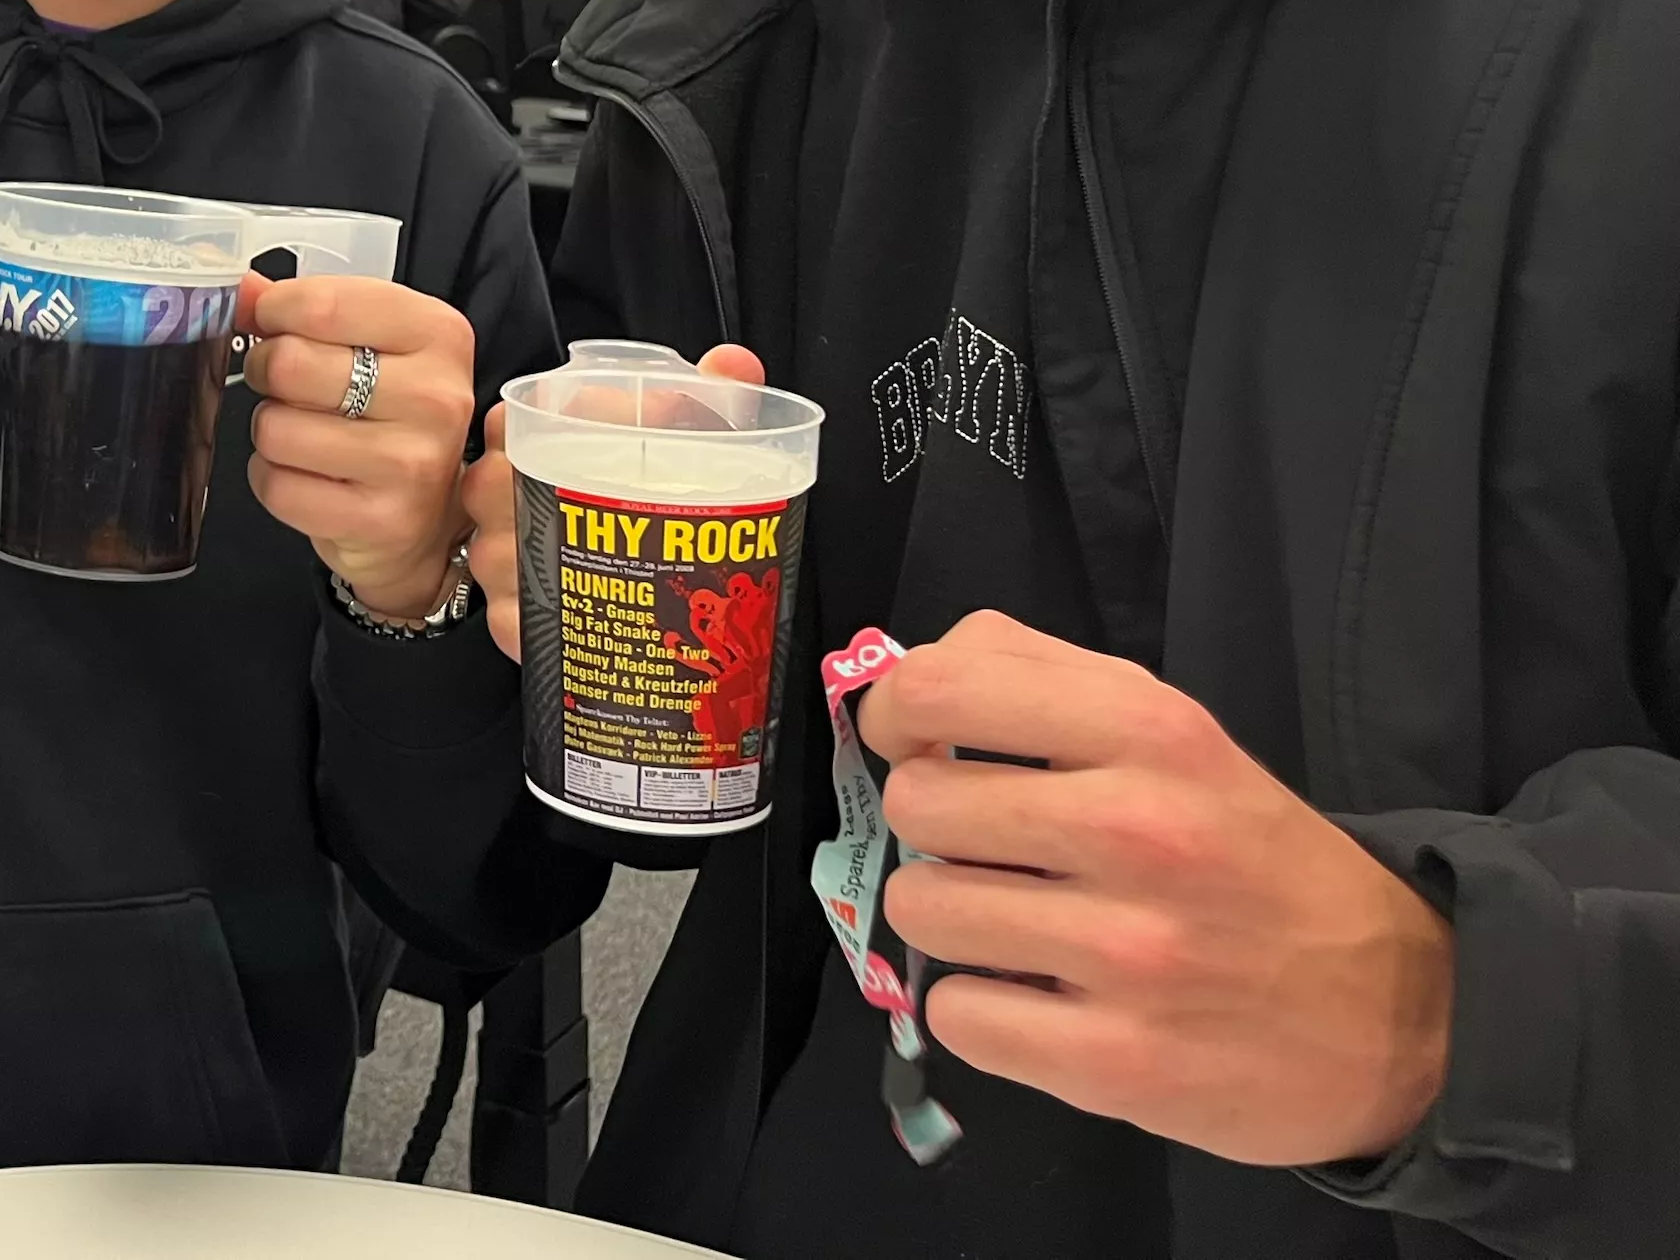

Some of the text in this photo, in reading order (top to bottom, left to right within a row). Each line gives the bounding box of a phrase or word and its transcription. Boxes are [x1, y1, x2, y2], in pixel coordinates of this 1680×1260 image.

[559, 502, 782, 564] THY ROCK
[561, 566, 654, 607] RUNRIG
[561, 609, 662, 642] Big Fat Snake
[606, 603, 656, 626] Gnags
[561, 626, 585, 645] Shu
[587, 633, 602, 650] Bi
[604, 637, 632, 655] Dua
[646, 643, 676, 660] One
[681, 645, 710, 661] Two
[562, 643, 674, 676] Johnny Madsen
[563, 660, 718, 694] Rugsted & Kreutzfeldt
[563, 677, 702, 714] Danser med Drenge
[634, 738, 658, 751] Rock
[660, 741, 683, 752] Hard
[656, 729, 679, 740] Veto
[633, 750, 667, 763] Patrick
[853, 775, 871, 814] Thy
